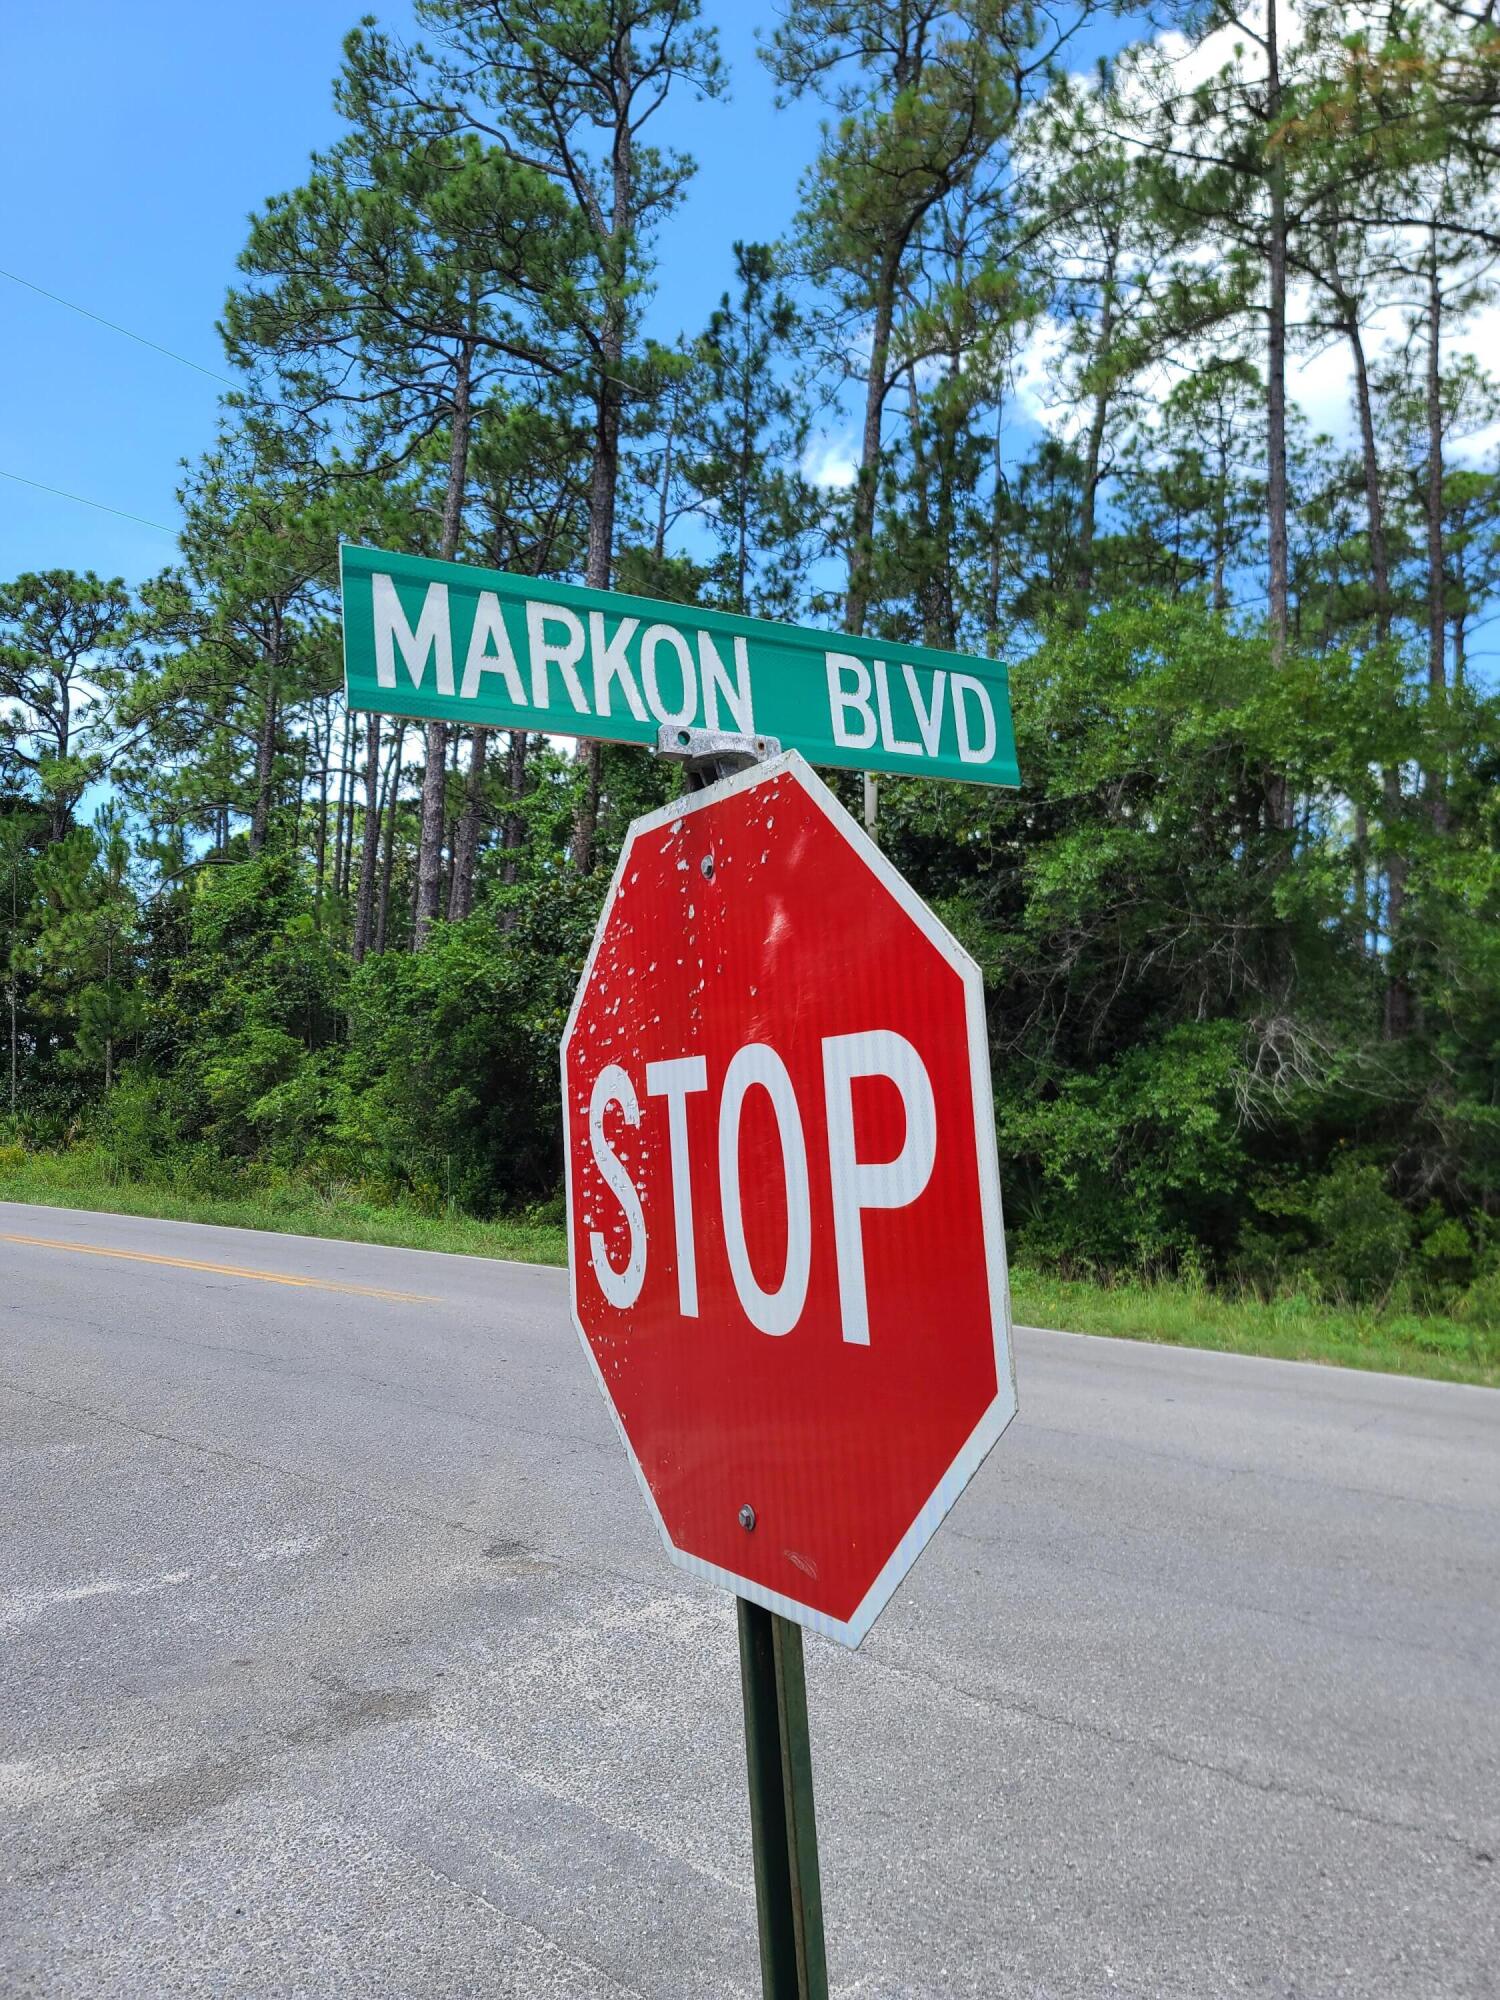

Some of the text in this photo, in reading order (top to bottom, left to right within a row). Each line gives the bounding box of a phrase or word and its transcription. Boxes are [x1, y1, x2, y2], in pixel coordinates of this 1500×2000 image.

[371, 573, 997, 765] MARKON BLVD
[589, 1029, 937, 1346] STOP
